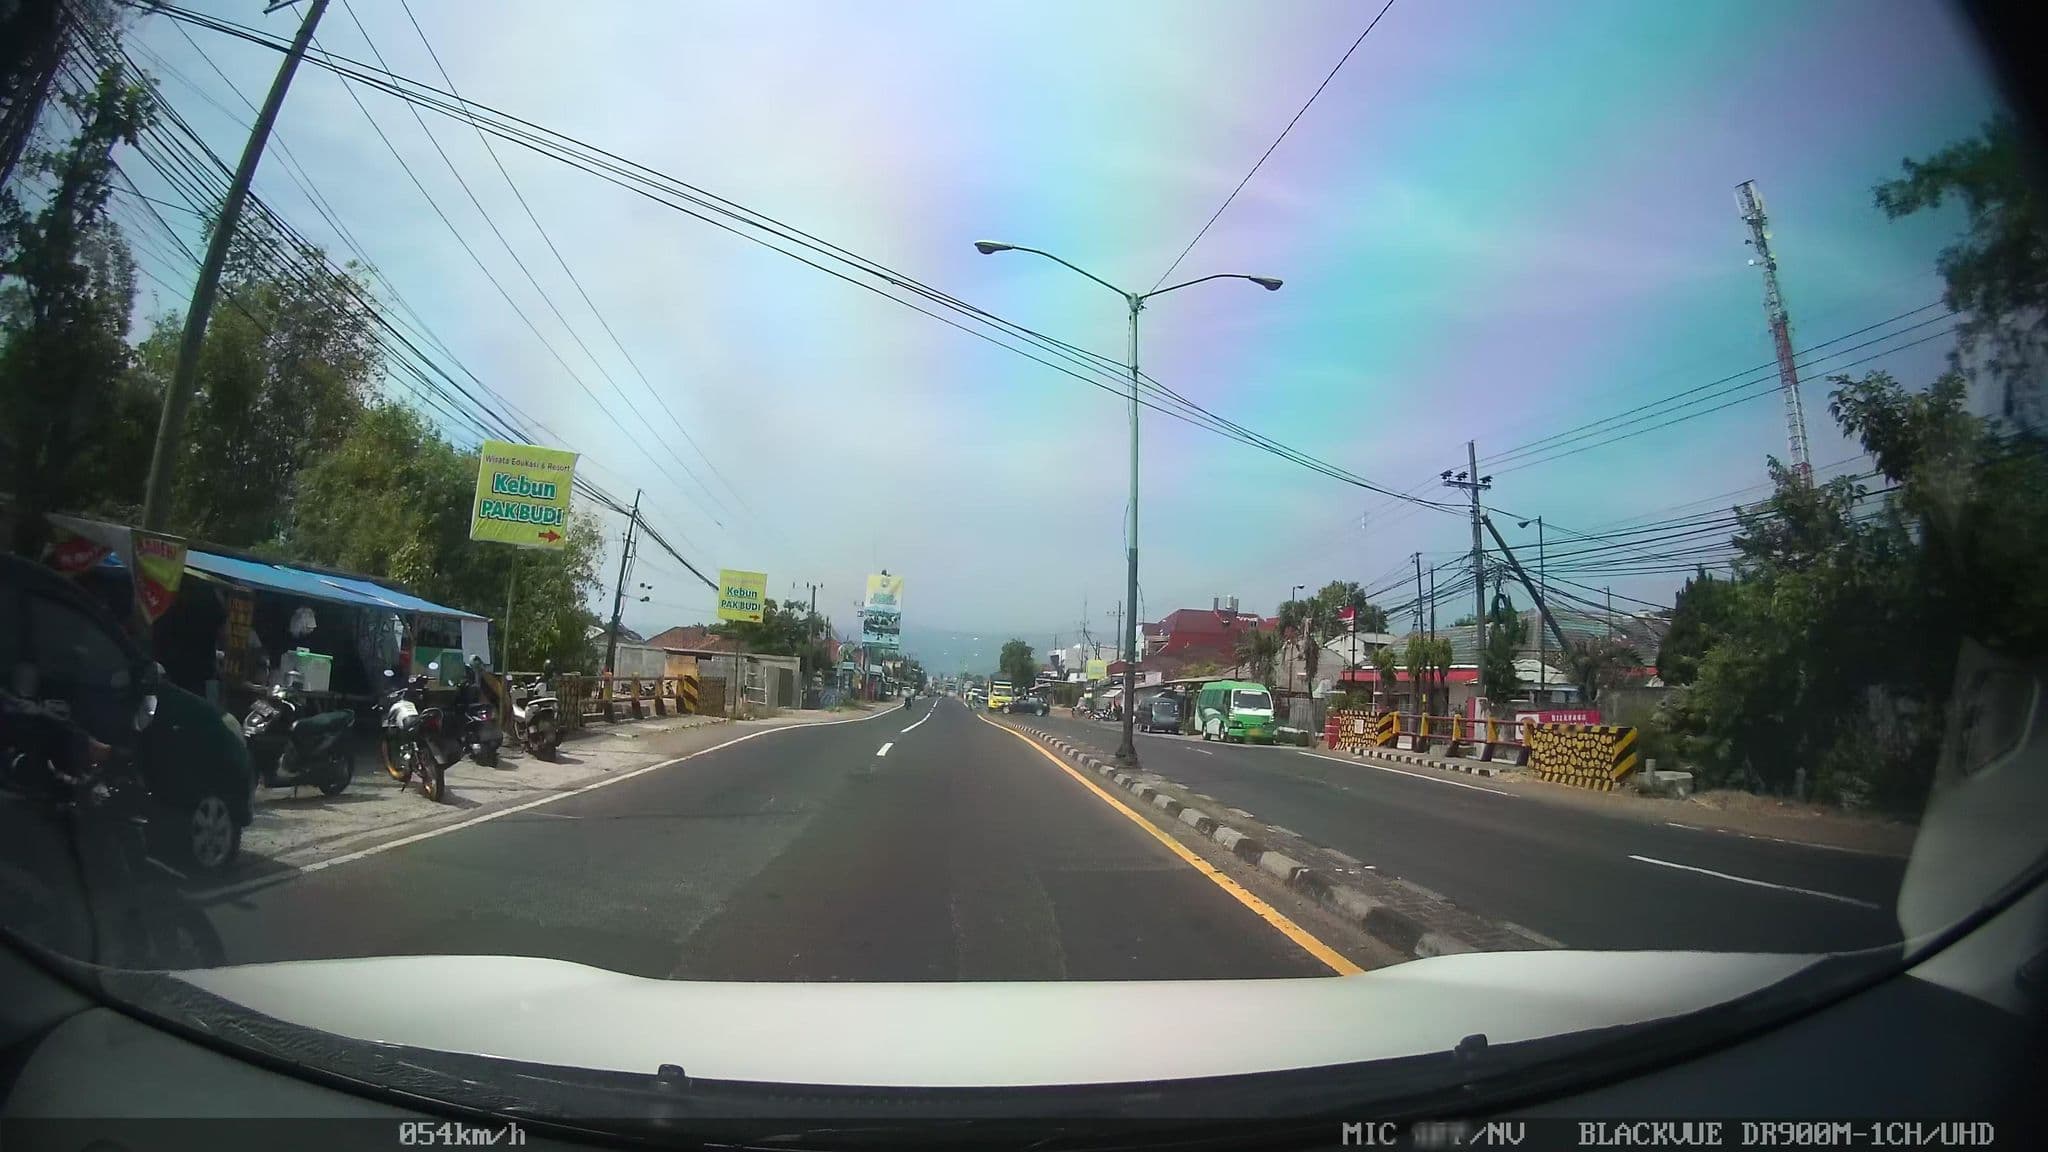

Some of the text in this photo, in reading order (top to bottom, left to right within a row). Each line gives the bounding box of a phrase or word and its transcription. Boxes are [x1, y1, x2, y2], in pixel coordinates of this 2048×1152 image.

[547, 462, 570, 472] Resort
[493, 472, 557, 499] Kebun
[480, 499, 564, 526] PAK BUDI
[727, 586, 758, 599] Kebun
[721, 599, 761, 611] PAK BUDI
